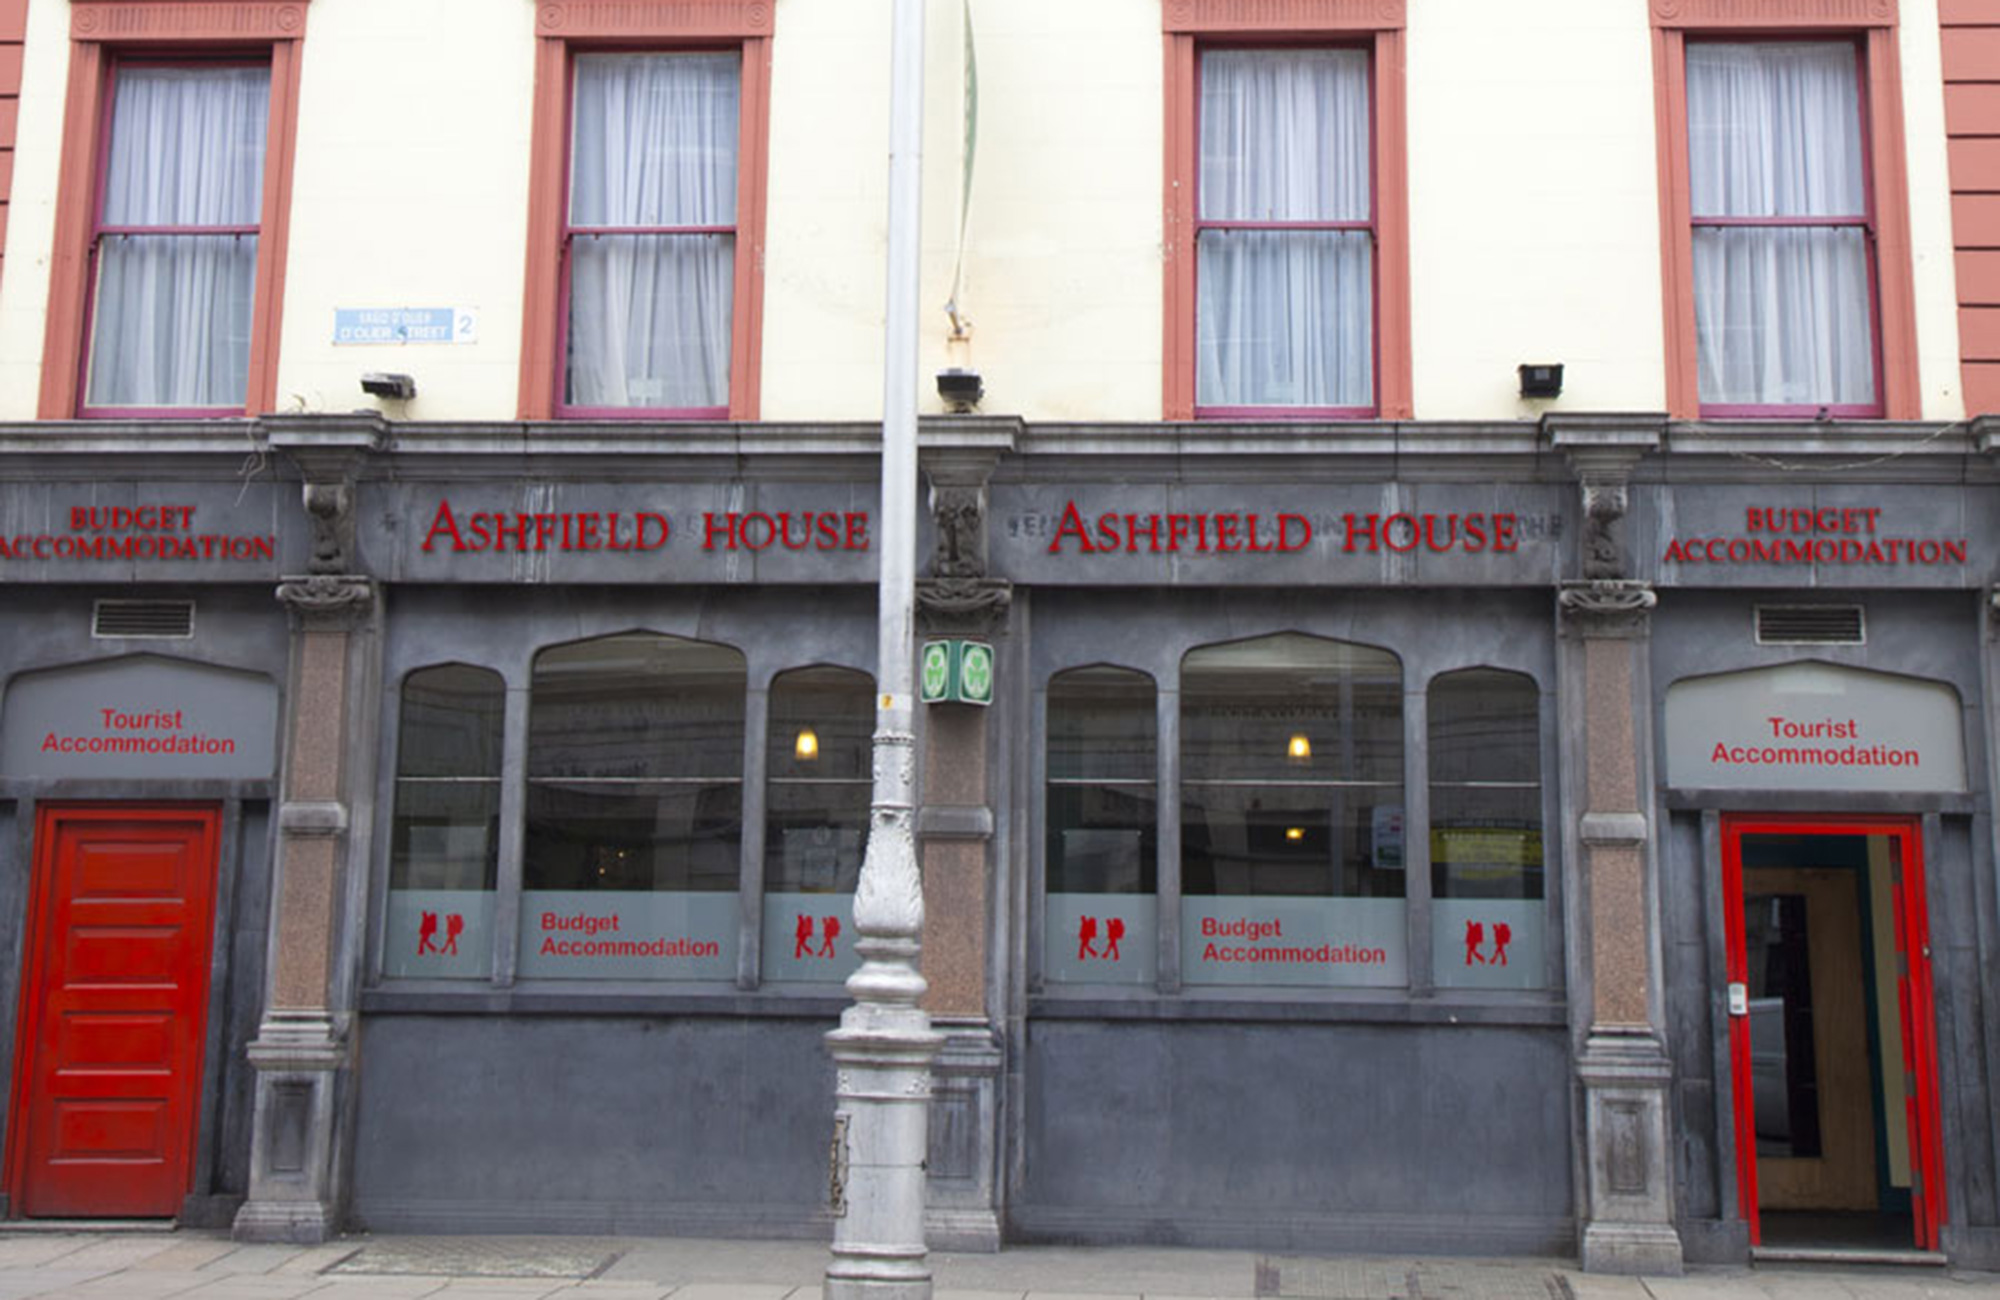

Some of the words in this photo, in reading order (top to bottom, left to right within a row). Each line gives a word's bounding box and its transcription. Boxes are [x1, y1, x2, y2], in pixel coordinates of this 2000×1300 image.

[459, 315, 473, 335] 2
[70, 505, 195, 531] BUDGET
[421, 499, 670, 552] ASHFIELD
[702, 510, 870, 551] HOUSE
[1049, 500, 1313, 553] ASHFIELD
[1342, 511, 1519, 553] HOUSE
[1746, 506, 1882, 533] BUDGET
[1664, 538, 1967, 564] ACCOMMODATION
[101, 708, 183, 730] Tourist
[1768, 717, 1858, 739] Tourist
[41, 732, 235, 755] Accommodation
[1711, 742, 1920, 767] Accommodation
[541, 912, 619, 934] Budget
[1202, 917, 1282, 941] Budget
[541, 935, 719, 957] Accommodation
[1203, 943, 1386, 965] Accommodation
